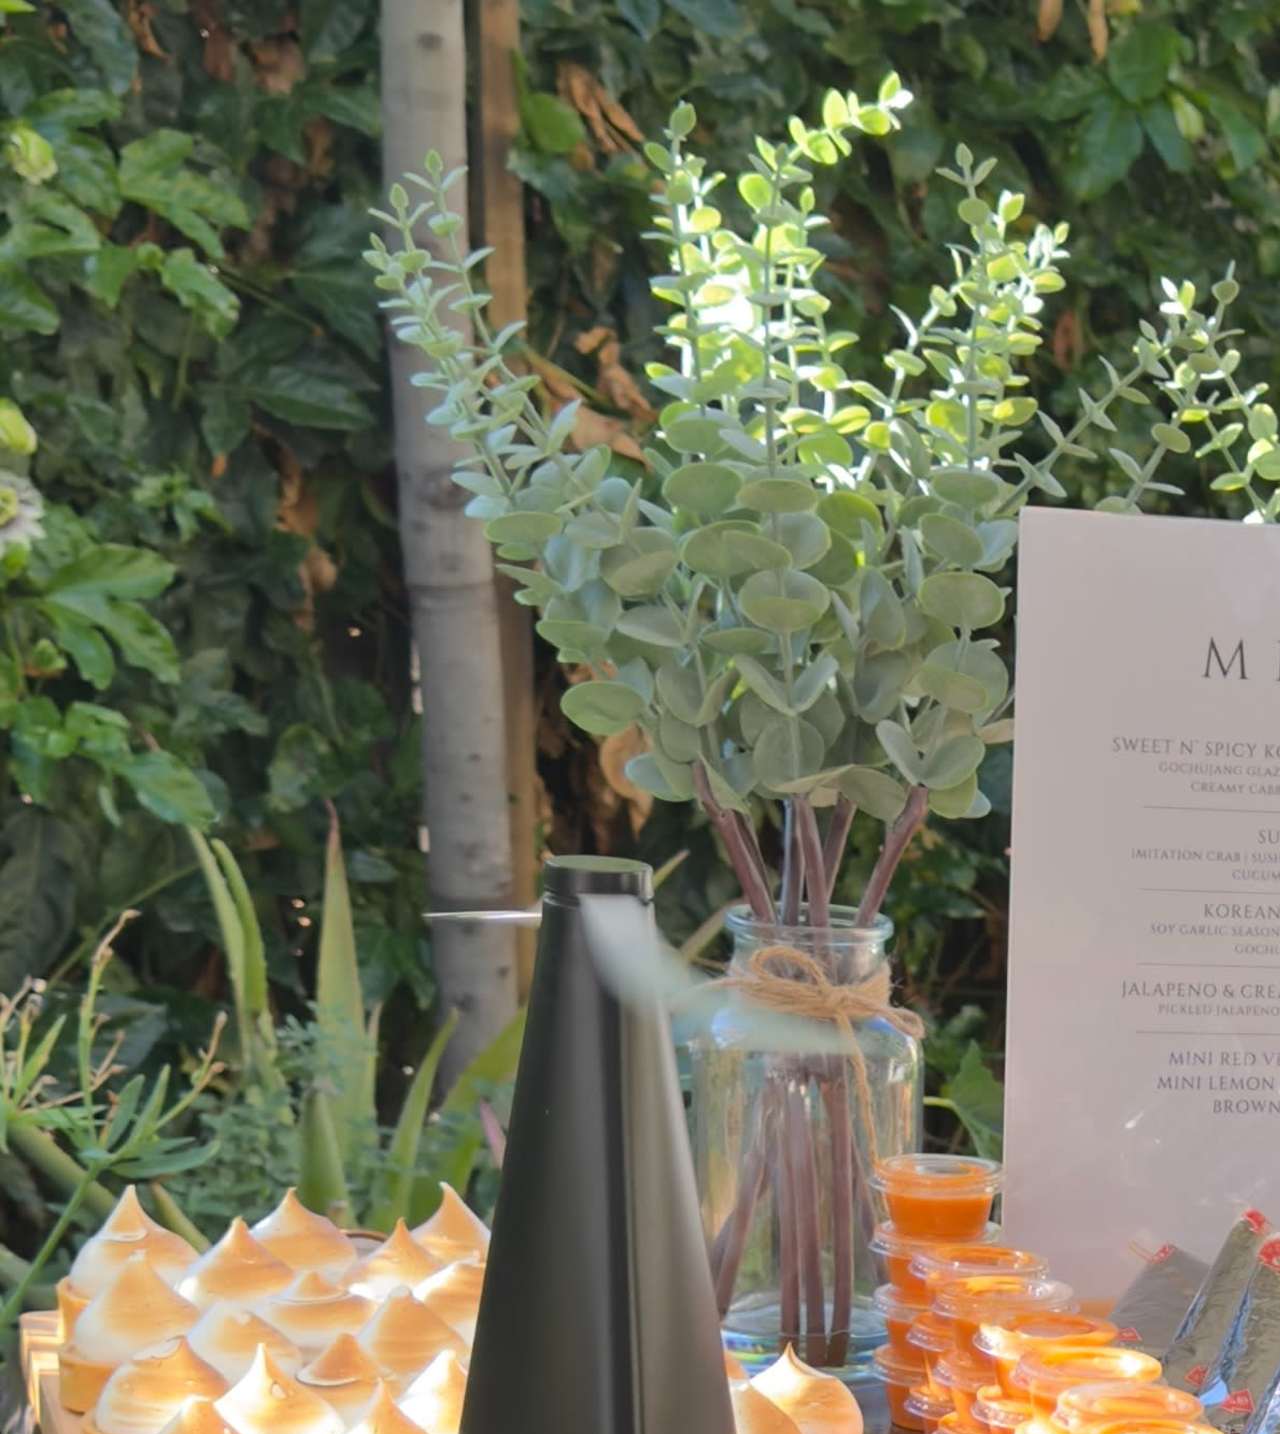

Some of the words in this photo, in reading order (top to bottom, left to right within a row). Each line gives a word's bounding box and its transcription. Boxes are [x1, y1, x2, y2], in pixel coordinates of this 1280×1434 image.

[1111, 736, 1174, 755] SWEET
[1205, 741, 1257, 758] SPICY
[1189, 781, 1245, 794] CREAMY
[1130, 848, 1202, 862] IMITATION
[1205, 850, 1241, 863] CRAB
[1203, 903, 1280, 920] KOREAN
[1149, 921, 1177, 935] SOY
[1179, 923, 1226, 937] GARLIC
[1120, 979, 1218, 999] JALAPENO
[1222, 984, 1235, 999] &
[1156, 1003, 1212, 1016] PICKLED
[1168, 1050, 1214, 1067] MINI
[1220, 1051, 1257, 1068] RED
[1155, 1075, 1202, 1091] MINI
[1208, 1075, 1275, 1092] LEMON
